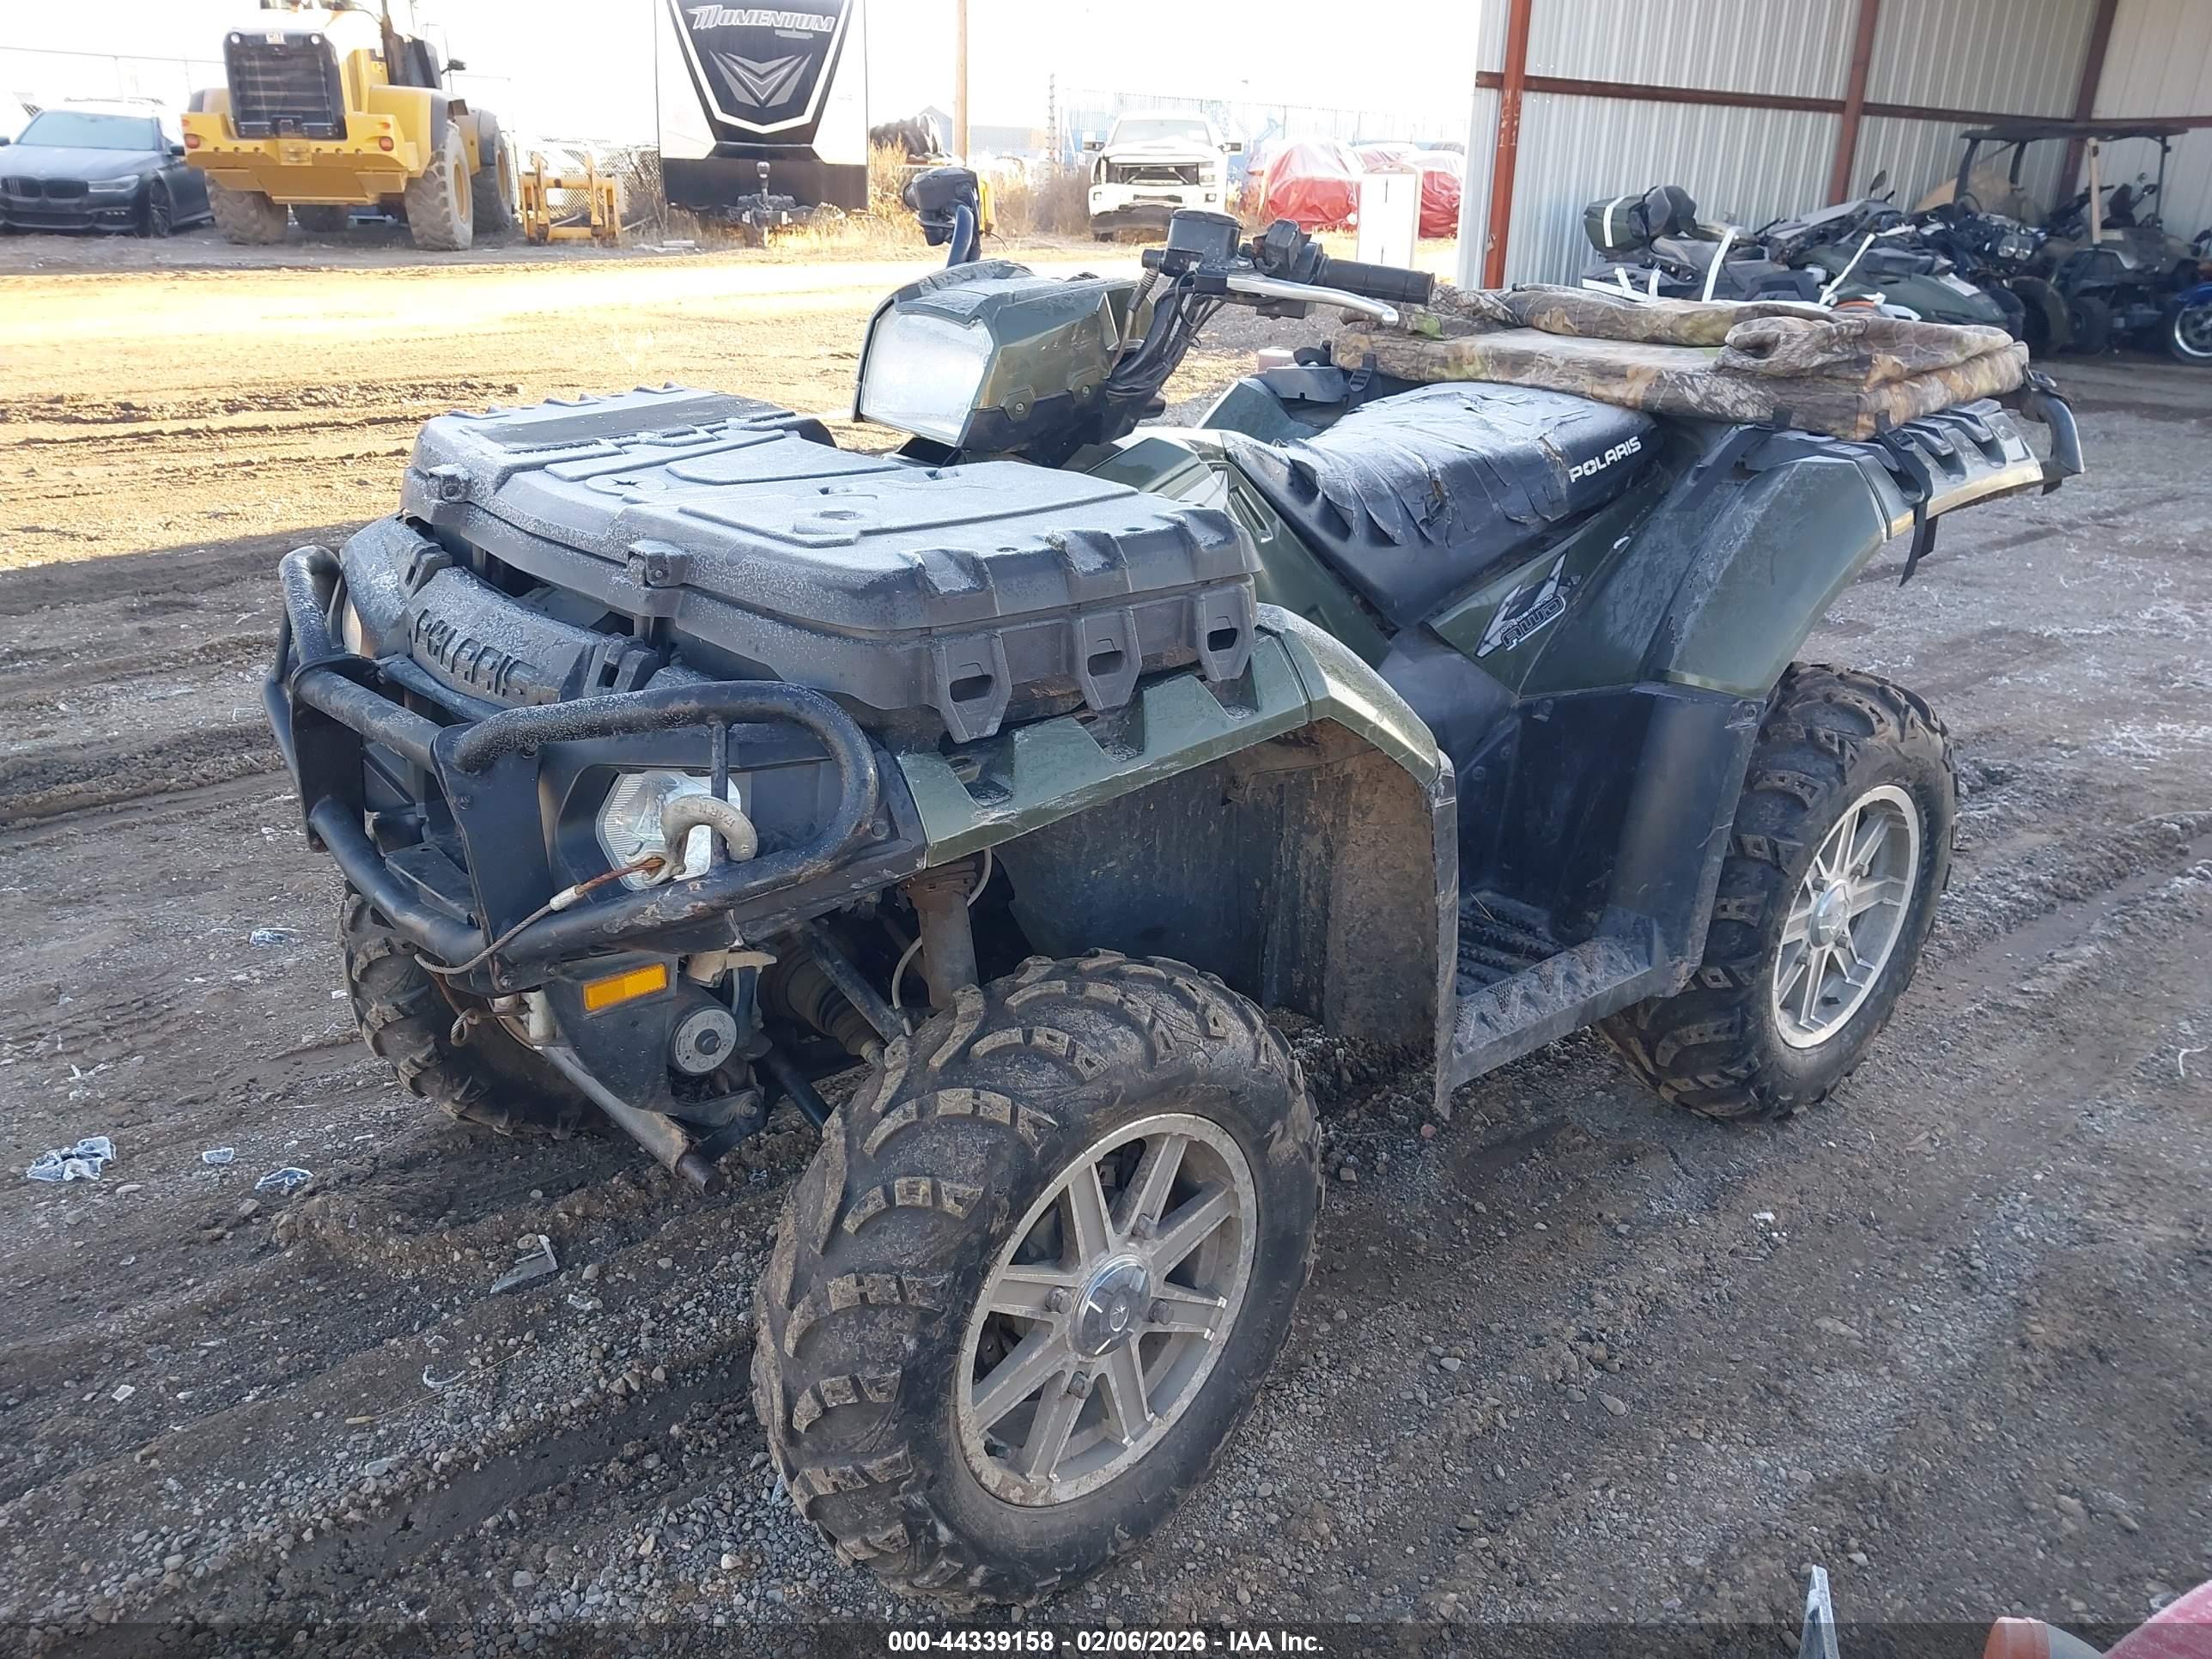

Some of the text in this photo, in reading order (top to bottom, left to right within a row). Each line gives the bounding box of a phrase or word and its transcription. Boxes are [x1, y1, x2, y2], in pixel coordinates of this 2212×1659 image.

[687, 4, 836, 32] MOMENTUM
[1568, 435, 1642, 483] POLARIS
[1501, 596, 1565, 648] AWD
